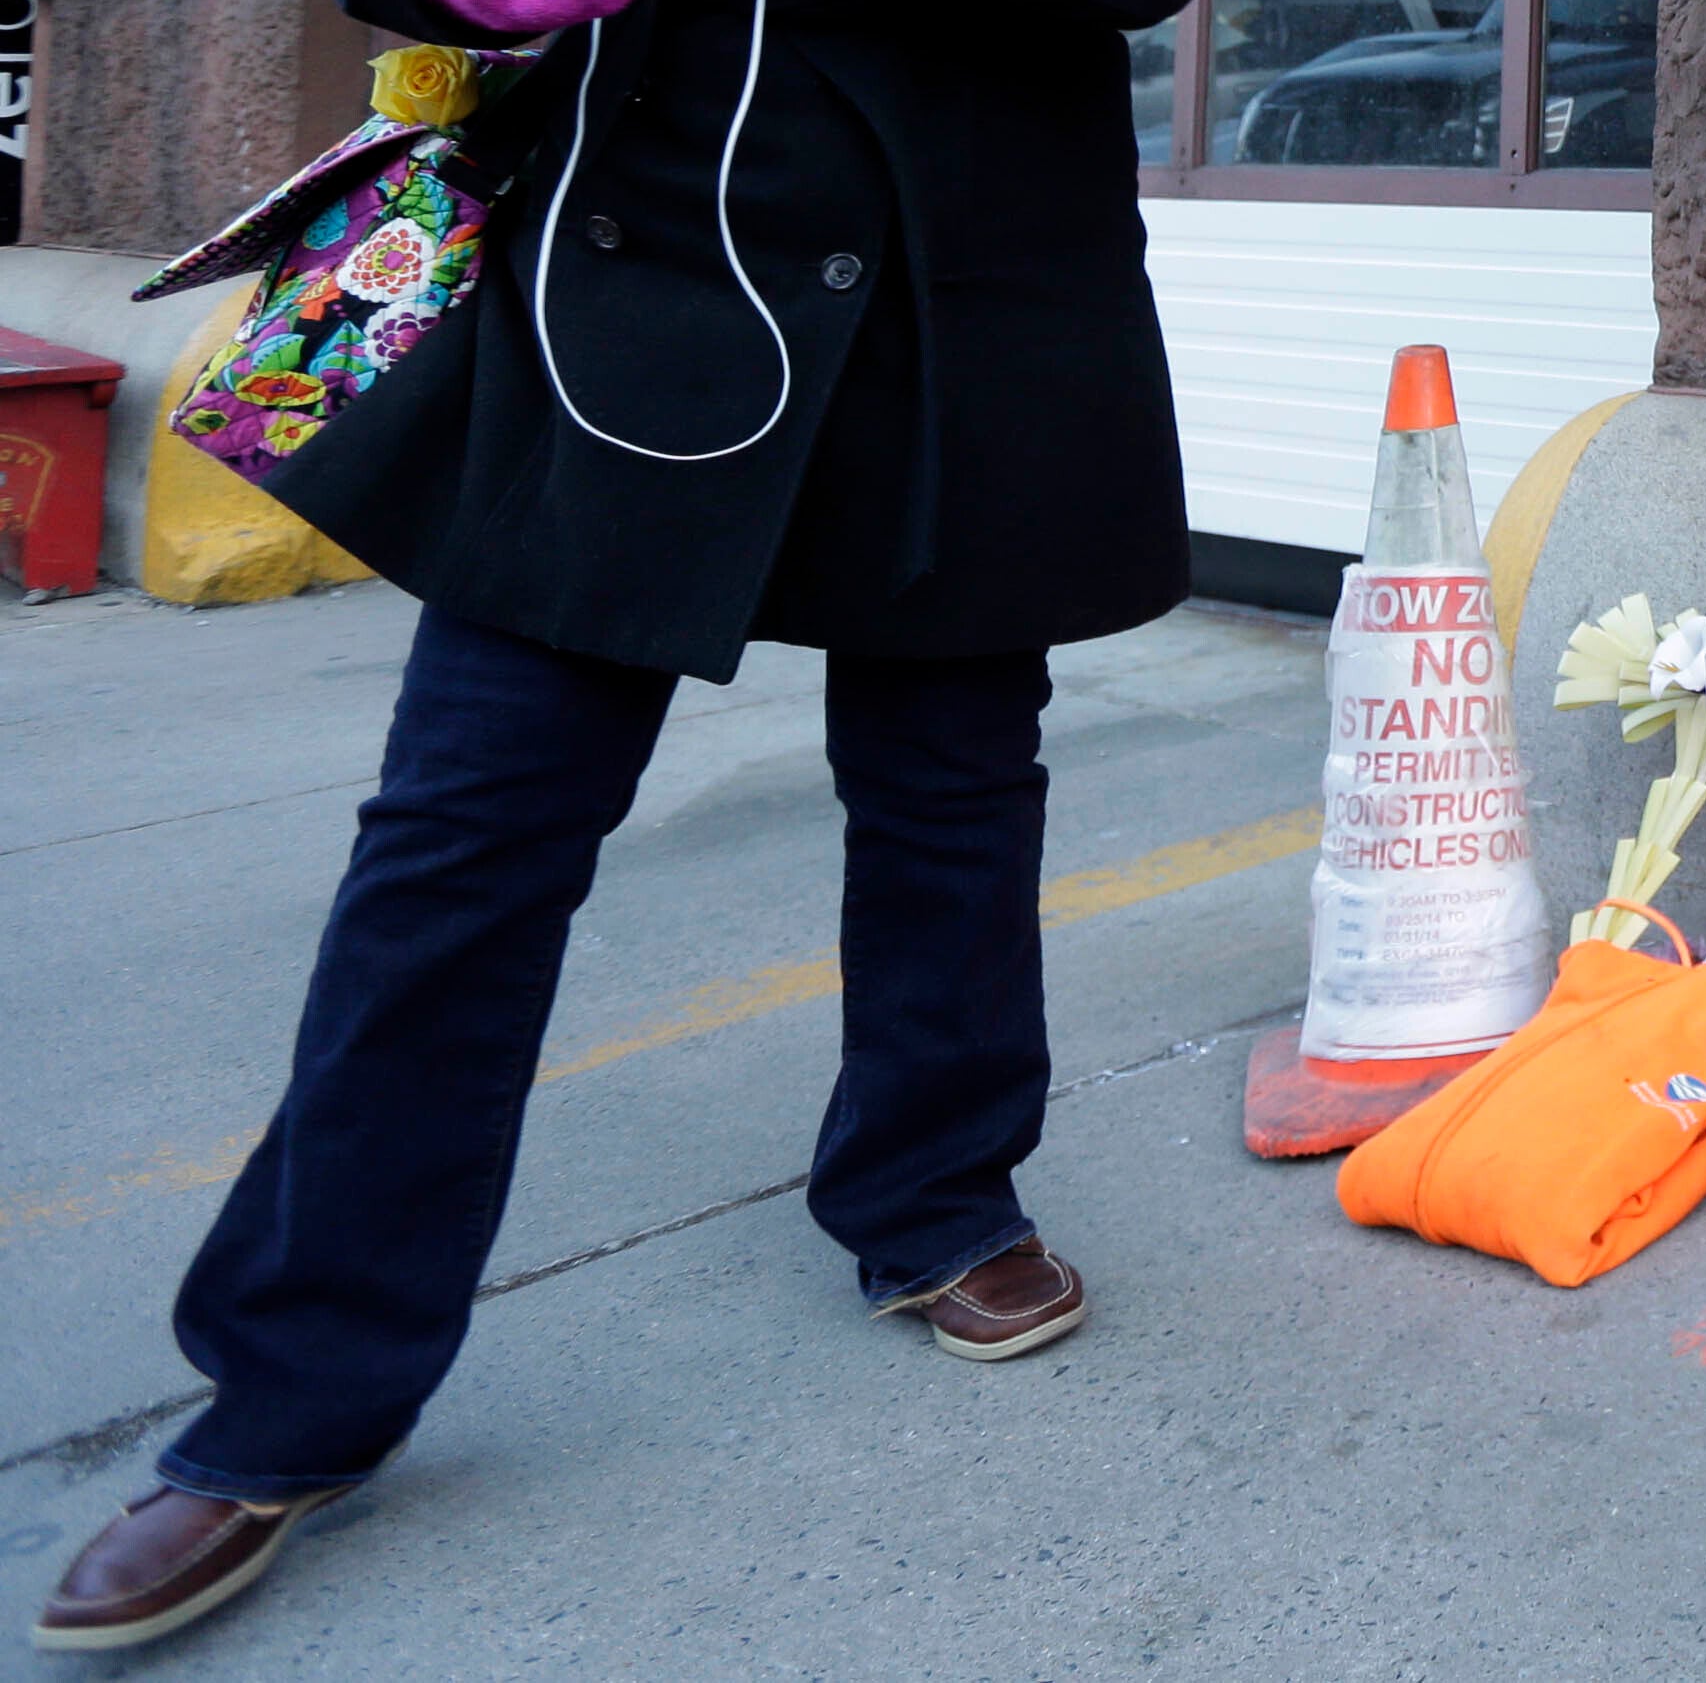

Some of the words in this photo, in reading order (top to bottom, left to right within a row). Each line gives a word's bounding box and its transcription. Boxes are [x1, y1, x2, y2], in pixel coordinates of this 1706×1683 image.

[1352, 584, 1448, 625] TOW
[1412, 636, 1493, 686] NO
[1333, 833, 1480, 871] VEHICLES
